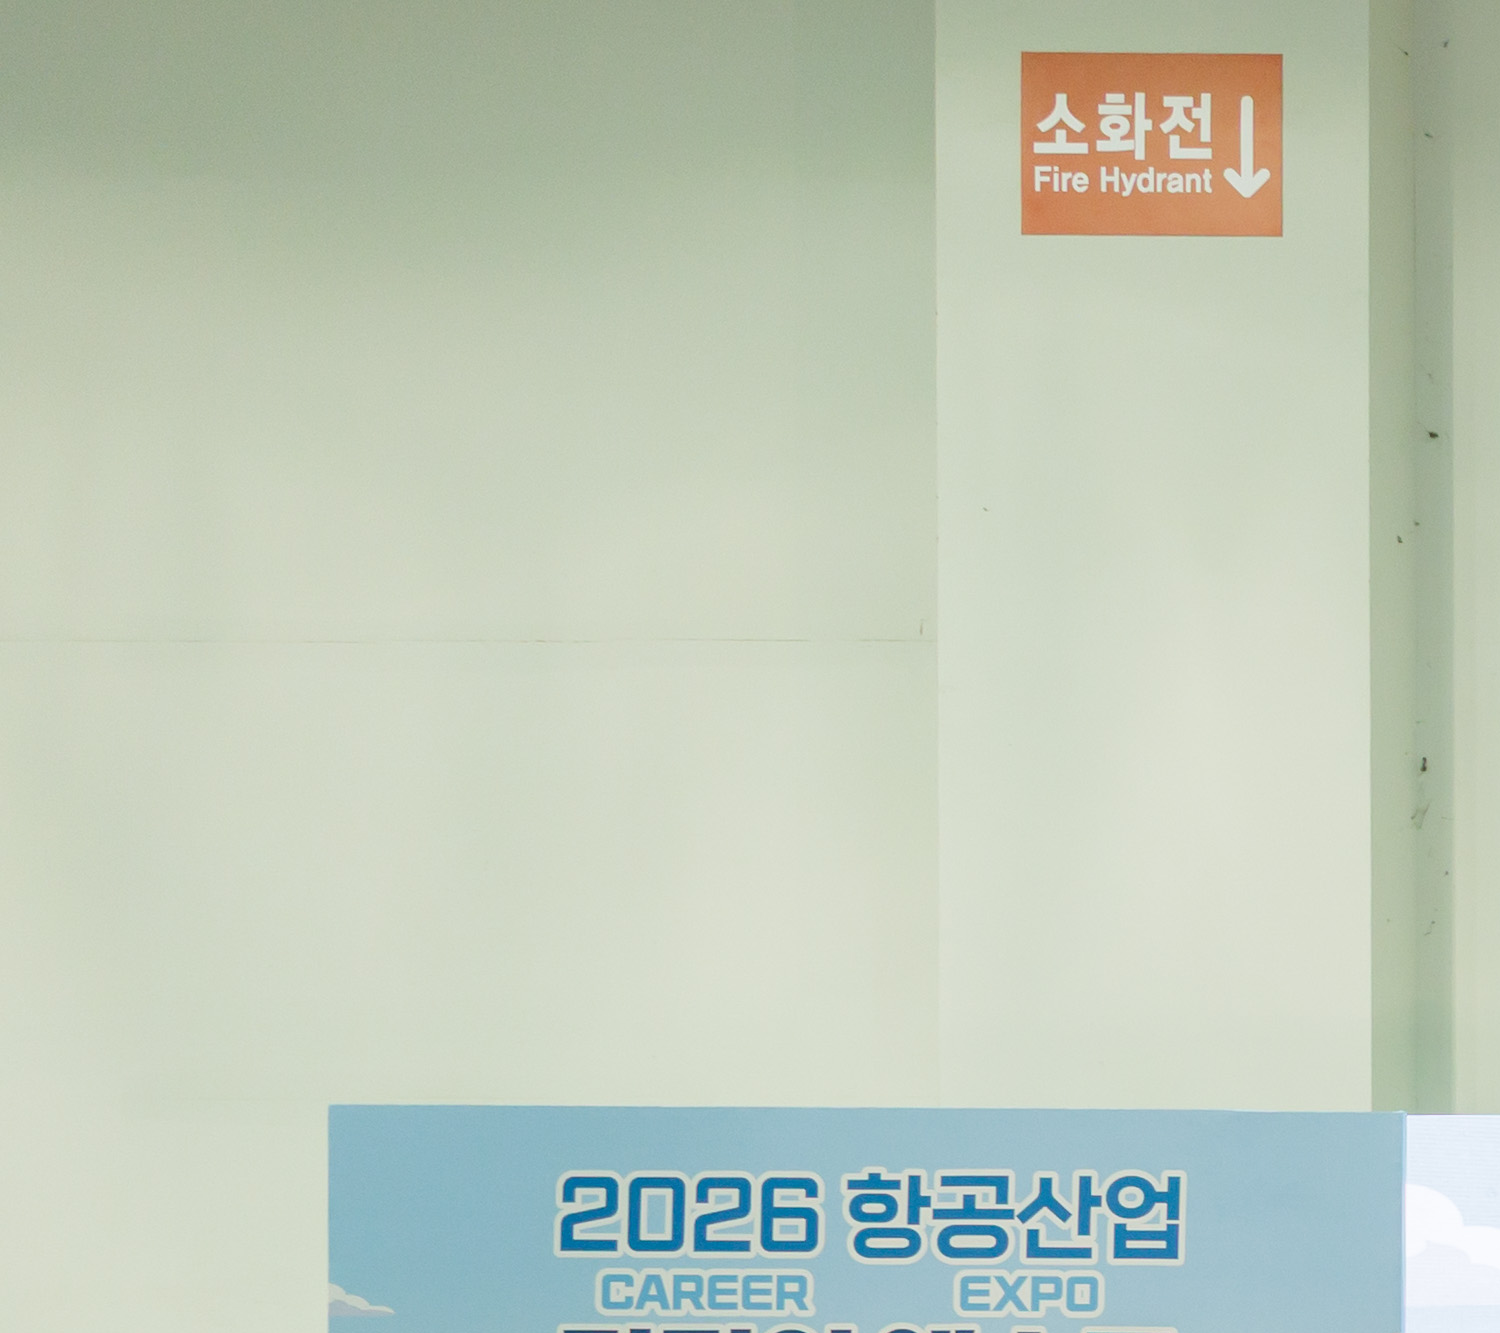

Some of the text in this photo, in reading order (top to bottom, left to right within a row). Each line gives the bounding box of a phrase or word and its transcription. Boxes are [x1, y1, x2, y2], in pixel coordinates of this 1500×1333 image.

[1033, 92, 1213, 160] 소화전
[1034, 166, 1213, 197] Fire Hydrant
[557, 1170, 1184, 1263] 2026 항공산업
[601, 1274, 1101, 1315] CAREER EXPO
